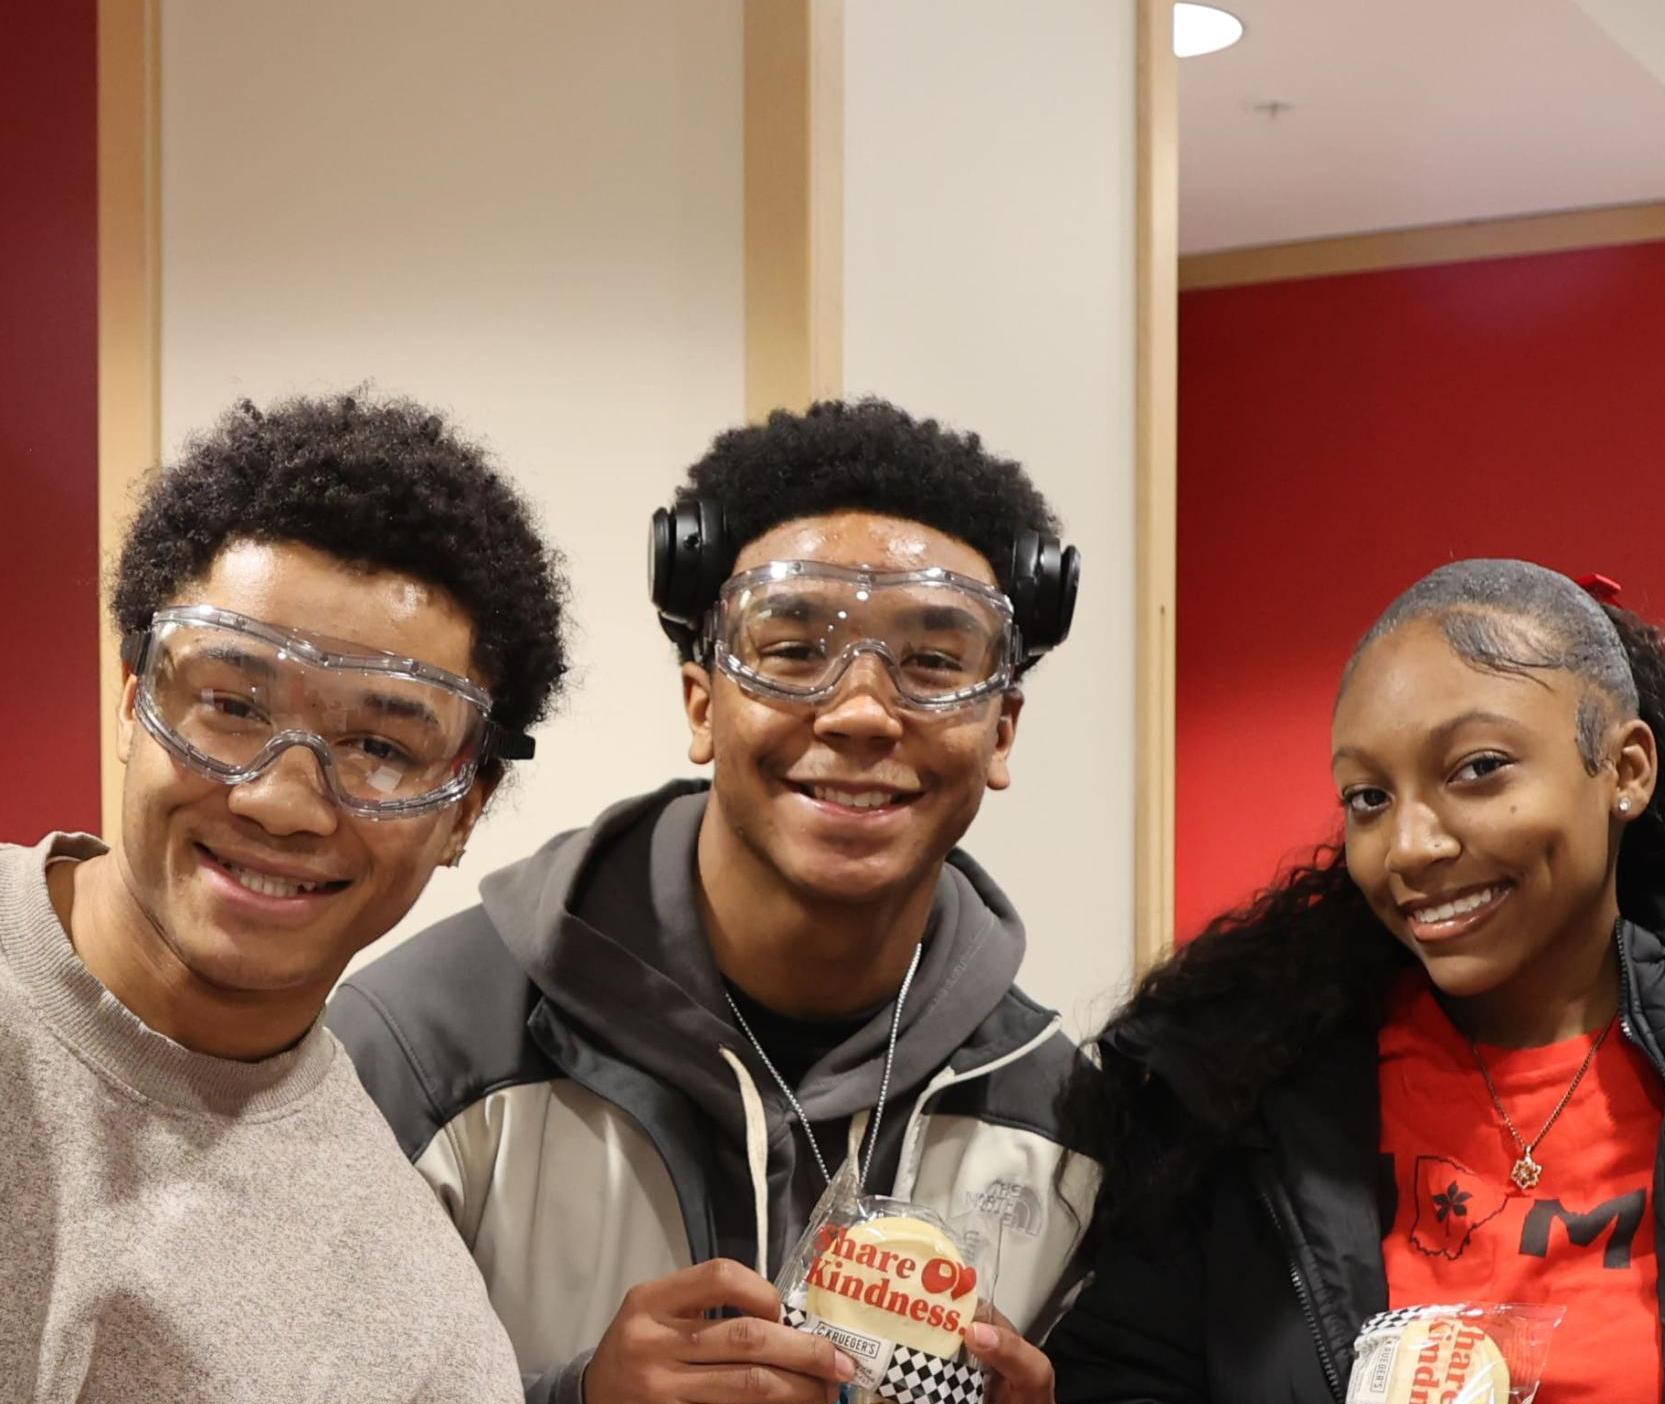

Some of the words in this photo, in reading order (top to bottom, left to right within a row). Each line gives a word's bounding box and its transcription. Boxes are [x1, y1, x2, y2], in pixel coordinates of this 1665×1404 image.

[814, 1224, 917, 1280] Share
[1519, 1187, 1647, 1269] M
[804, 1256, 967, 1337] Kindness.
[817, 1325, 877, 1356] C.KRUEGER'S
